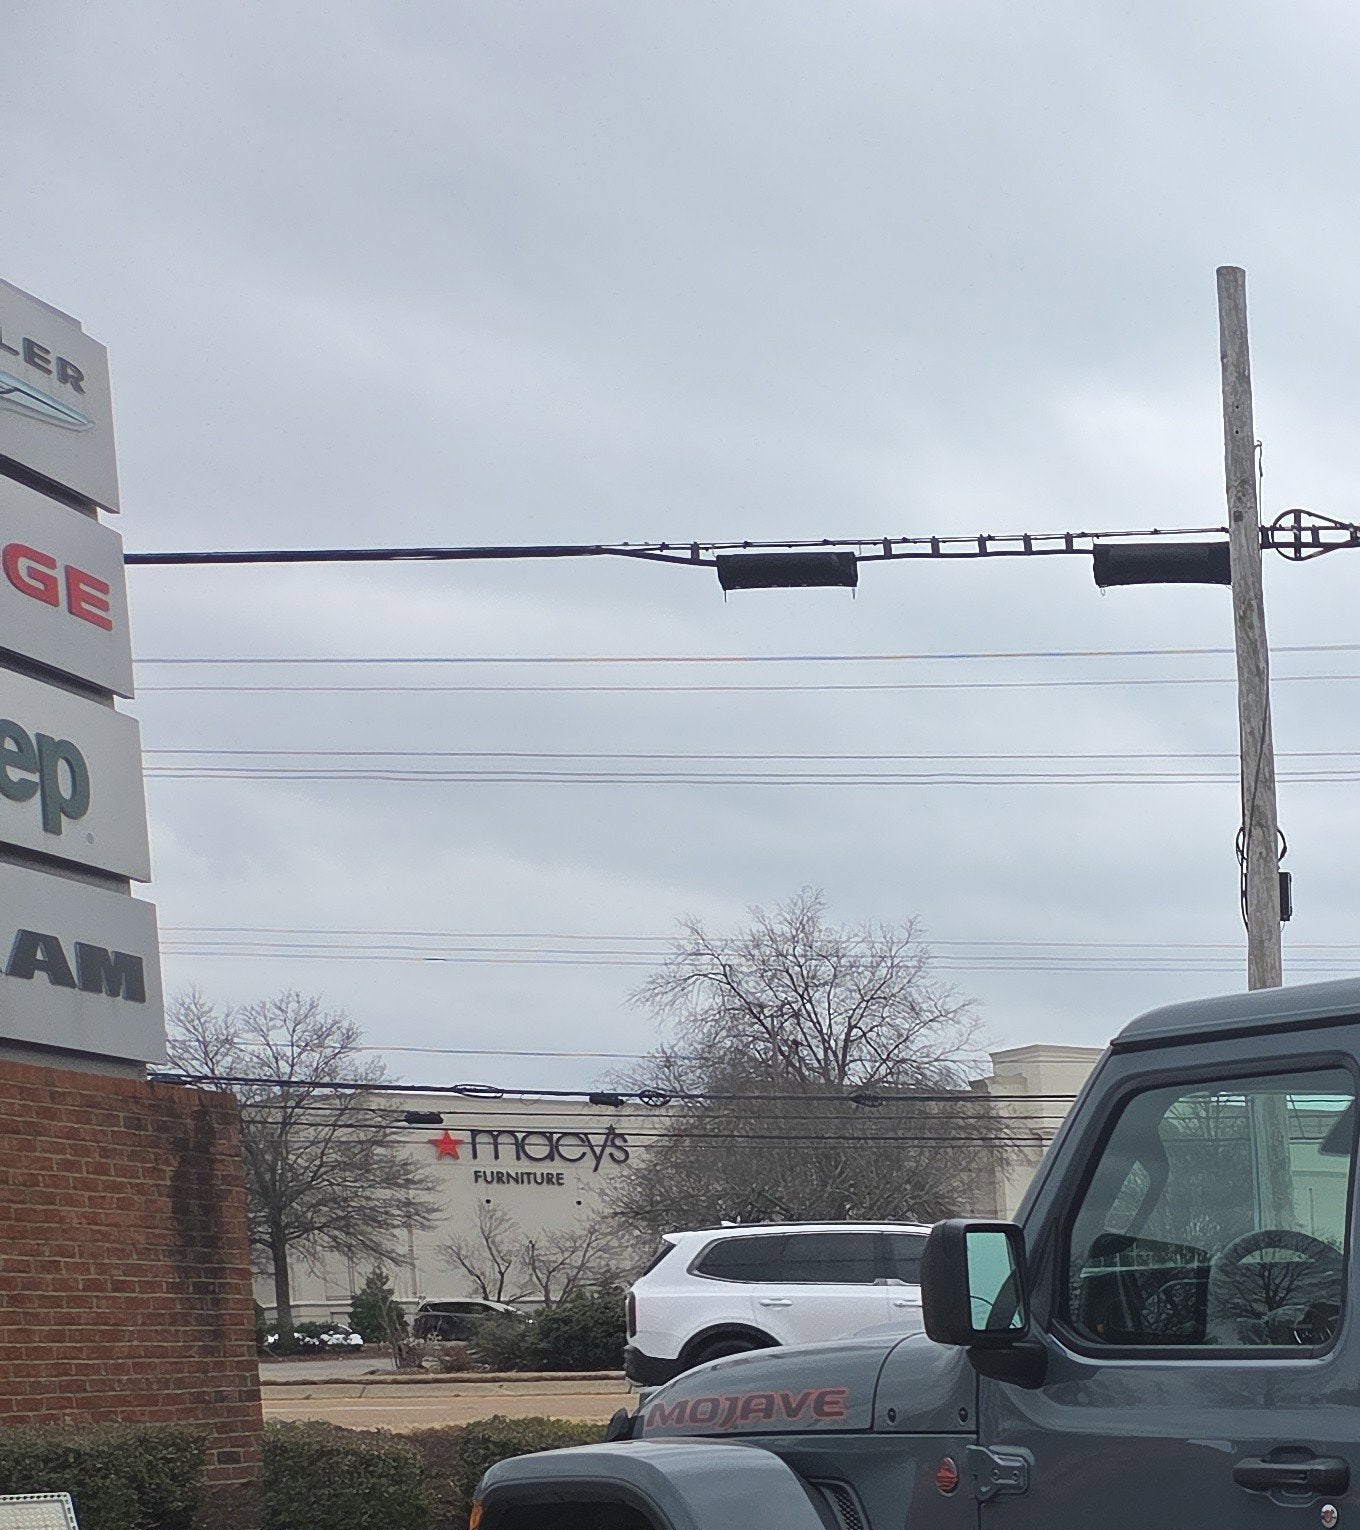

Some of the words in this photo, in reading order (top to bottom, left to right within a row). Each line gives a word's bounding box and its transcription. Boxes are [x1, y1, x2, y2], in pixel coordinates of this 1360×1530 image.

[0, 929, 147, 1004] AM
[474, 1170, 565, 1186] FURNITURE
[644, 1387, 849, 1431] MOJAVE
